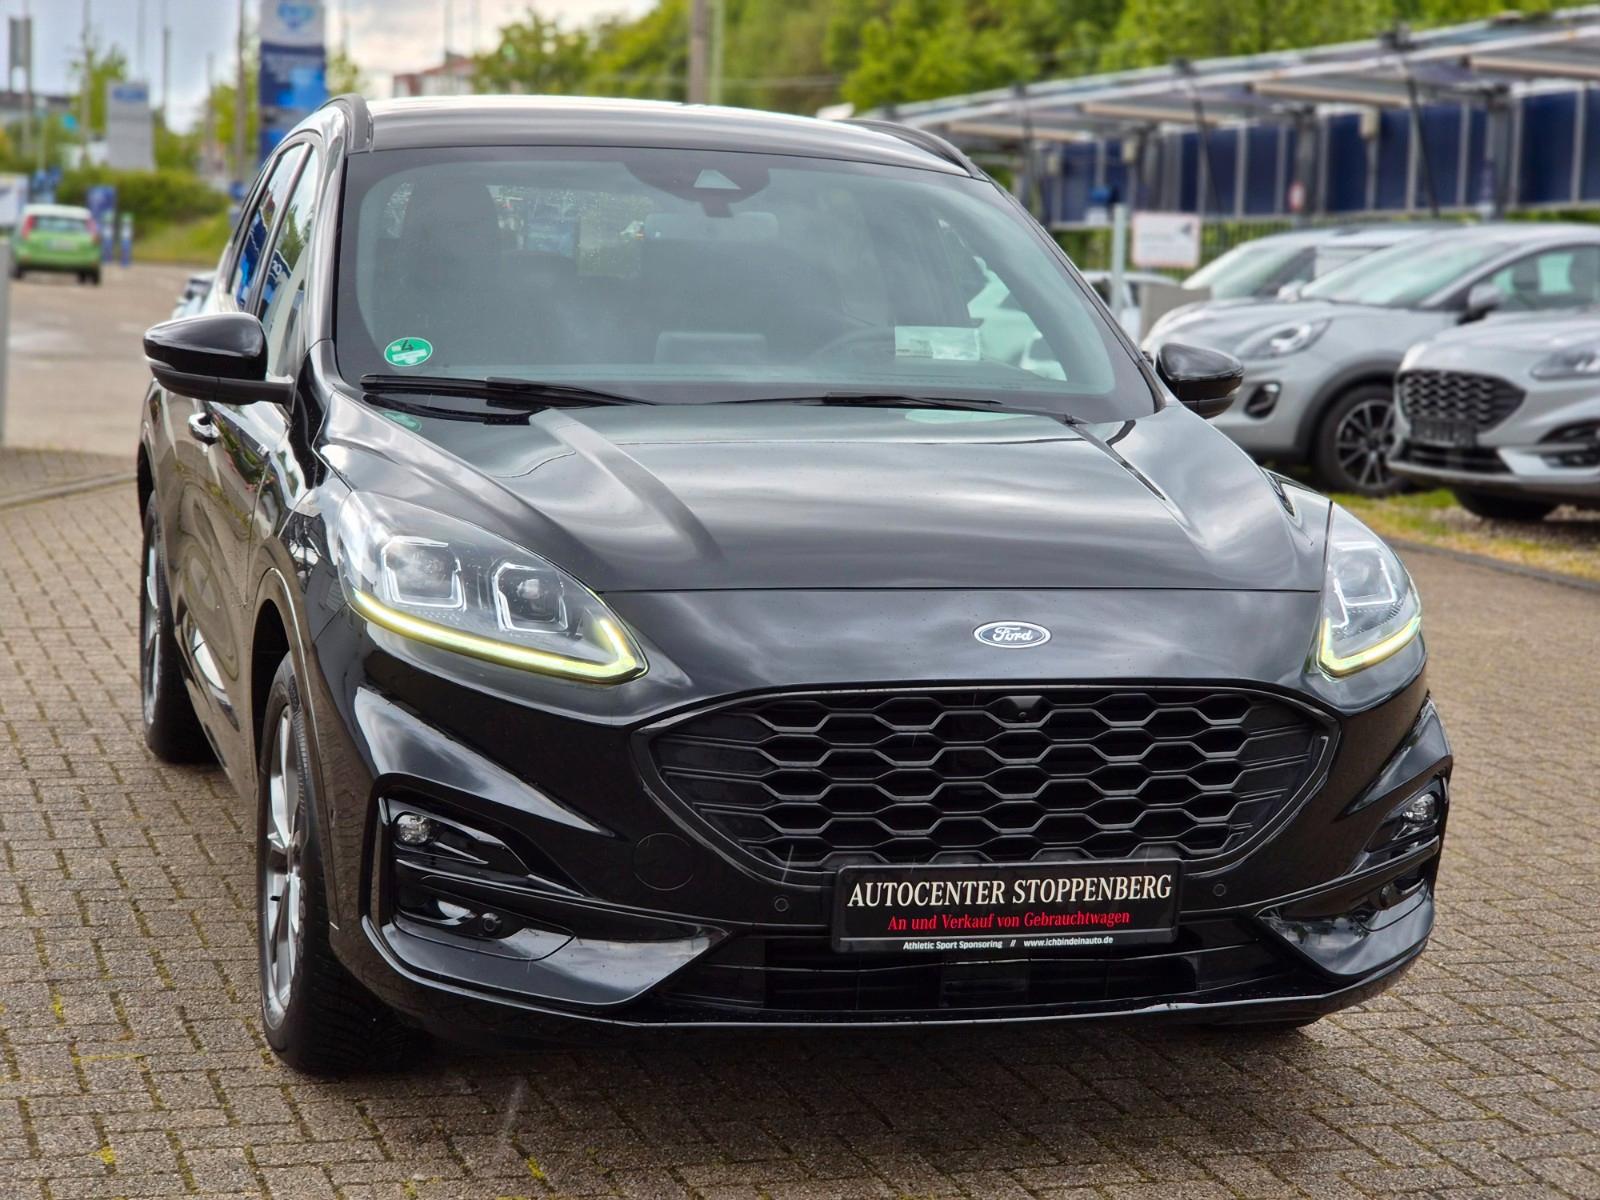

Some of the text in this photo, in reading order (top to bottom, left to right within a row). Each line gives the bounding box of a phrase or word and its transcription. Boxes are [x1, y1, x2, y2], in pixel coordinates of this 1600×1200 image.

[992, 626, 1033, 641] Ford
[847, 874, 1171, 906] AUTOCENTER STOPPENBERG
[888, 911, 1130, 931] An und Verkauf von Gebrauchtwagen
[903, 941, 934, 950] Athletic
[936, 941, 957, 951] Sport
[959, 940, 1003, 950] Sponsoring
[1024, 936, 1114, 948] www.ichbindeinauto.de
